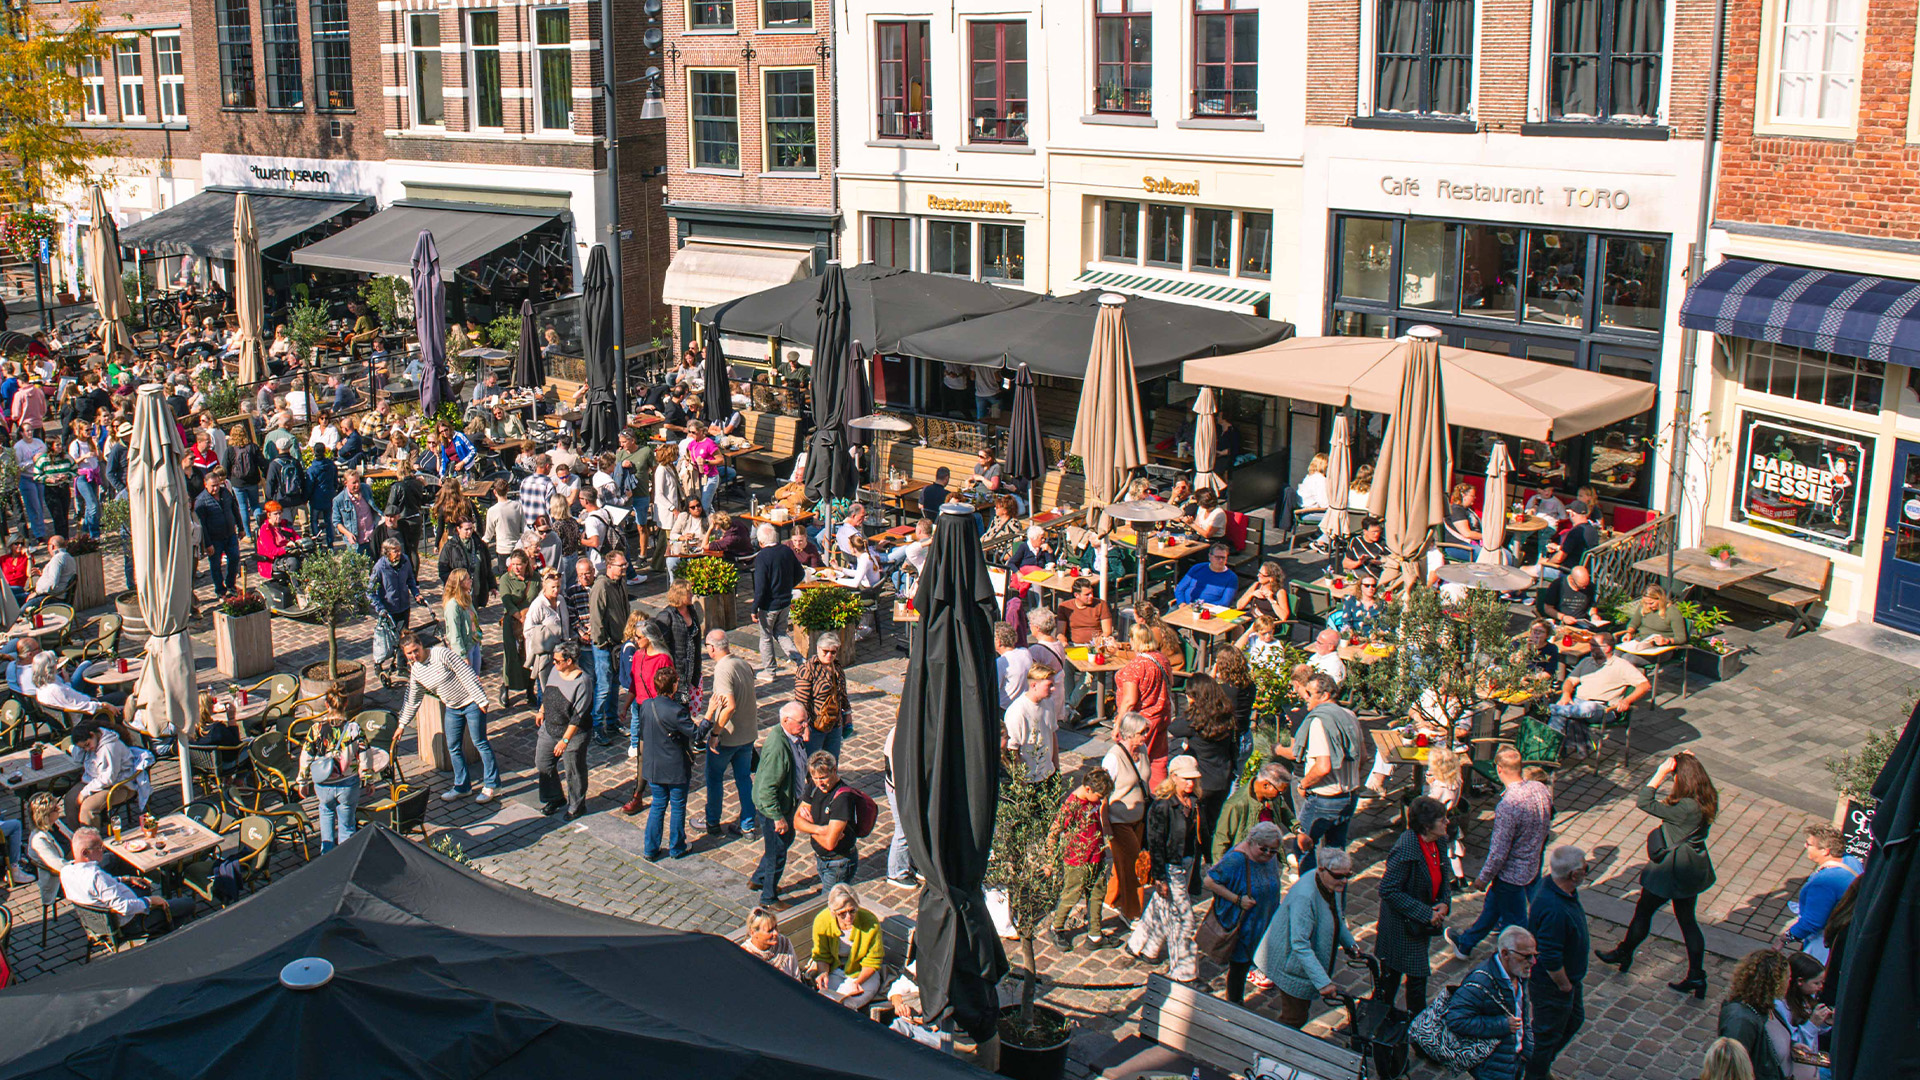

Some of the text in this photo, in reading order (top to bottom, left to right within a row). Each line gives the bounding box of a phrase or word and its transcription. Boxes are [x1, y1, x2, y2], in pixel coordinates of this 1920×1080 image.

[1142, 176, 1200, 196] Sultani
[1380, 176, 1630, 210] Café Restaurant TORO
[927, 193, 1012, 214] Restaurant
[1753, 453, 1834, 487] BARBER
[1751, 470, 1833, 506] JESSIE
